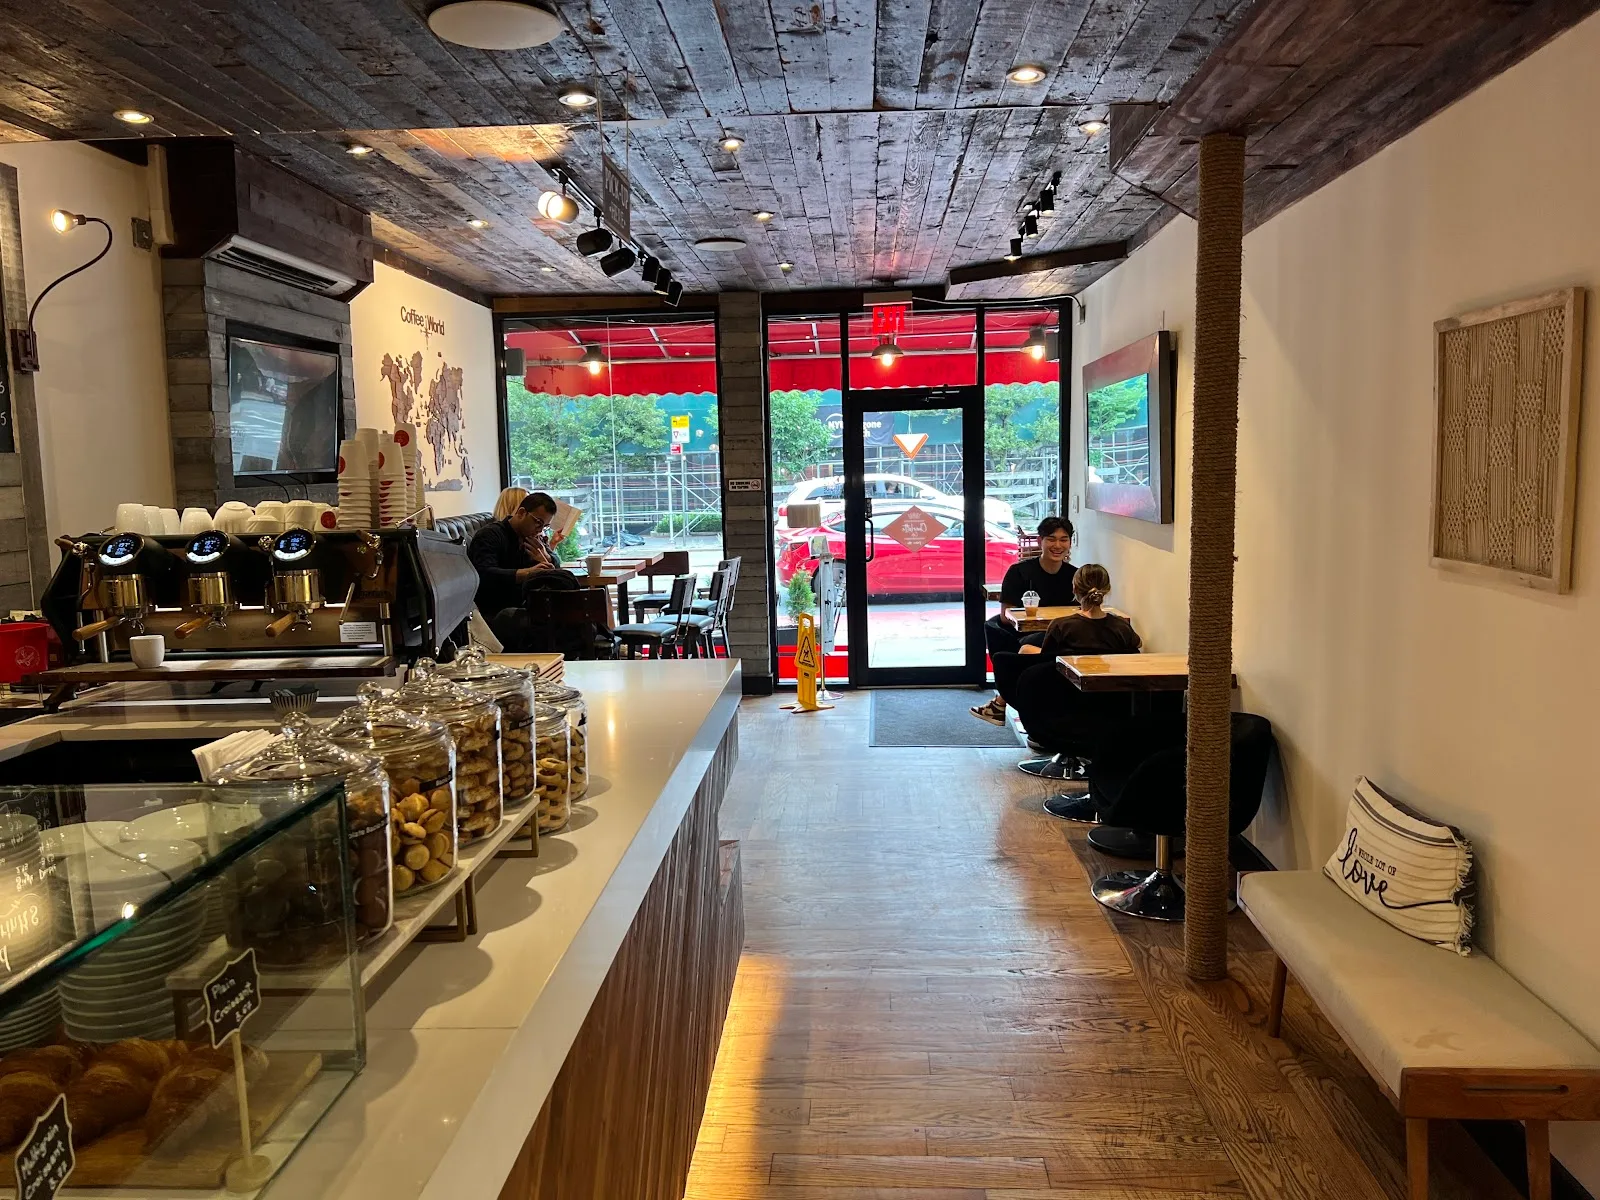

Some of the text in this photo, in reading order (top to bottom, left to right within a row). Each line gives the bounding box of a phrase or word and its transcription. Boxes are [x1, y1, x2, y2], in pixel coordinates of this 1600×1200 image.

[400, 305, 445, 335] Coffee World
[873, 305, 906, 334] EXIT
